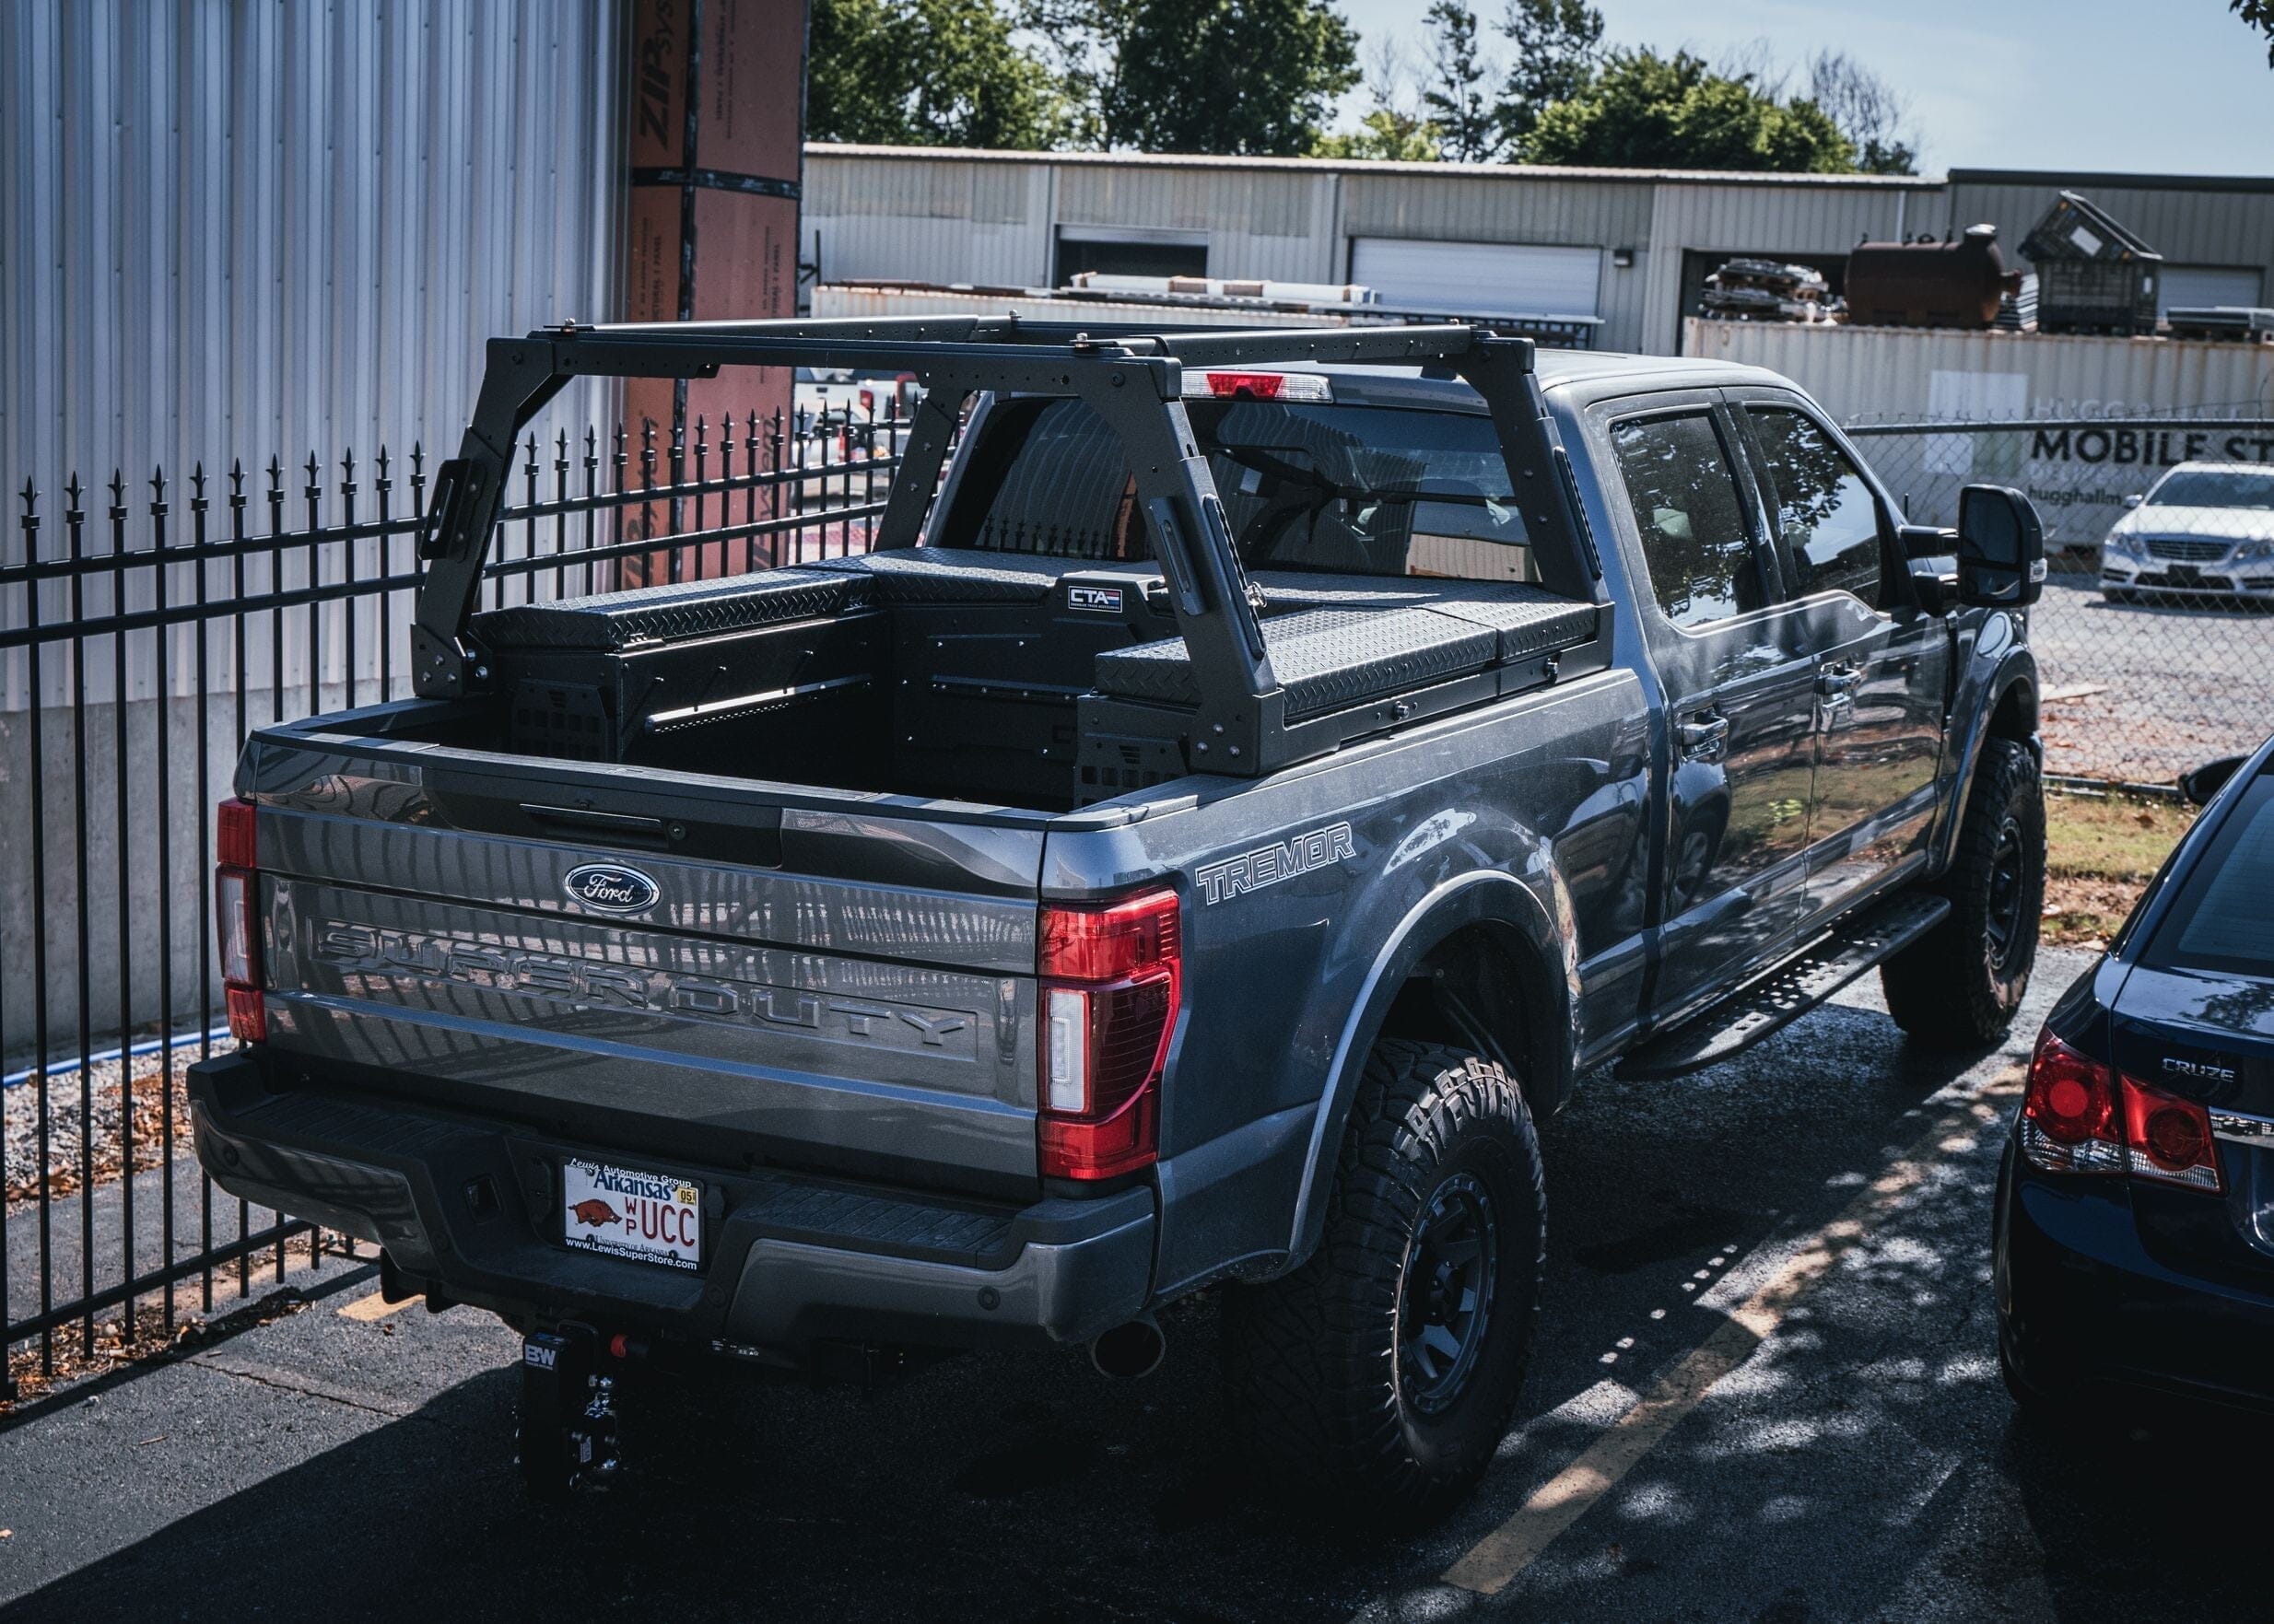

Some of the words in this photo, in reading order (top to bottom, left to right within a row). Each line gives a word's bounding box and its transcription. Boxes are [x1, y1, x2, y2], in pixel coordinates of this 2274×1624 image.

[2031, 429, 2208, 465] MOBILE
[1071, 589, 1108, 604] CTA
[1196, 821, 1356, 905] TREMOR
[583, 873, 635, 903] Ford
[319, 929, 649, 1010] SUPER
[671, 978, 966, 1046] DUTY
[2162, 1057, 2234, 1082] CRUZE
[569, 1157, 601, 1172] Lewis
[603, 1164, 658, 1182] Automotive
[661, 1174, 692, 1188] Group
[593, 1171, 672, 1201] Arkansas
[680, 1190, 692, 1201] 05
[641, 1199, 696, 1247] UCC
[565, 1238, 697, 1270] www.LewisSuperStore.com
